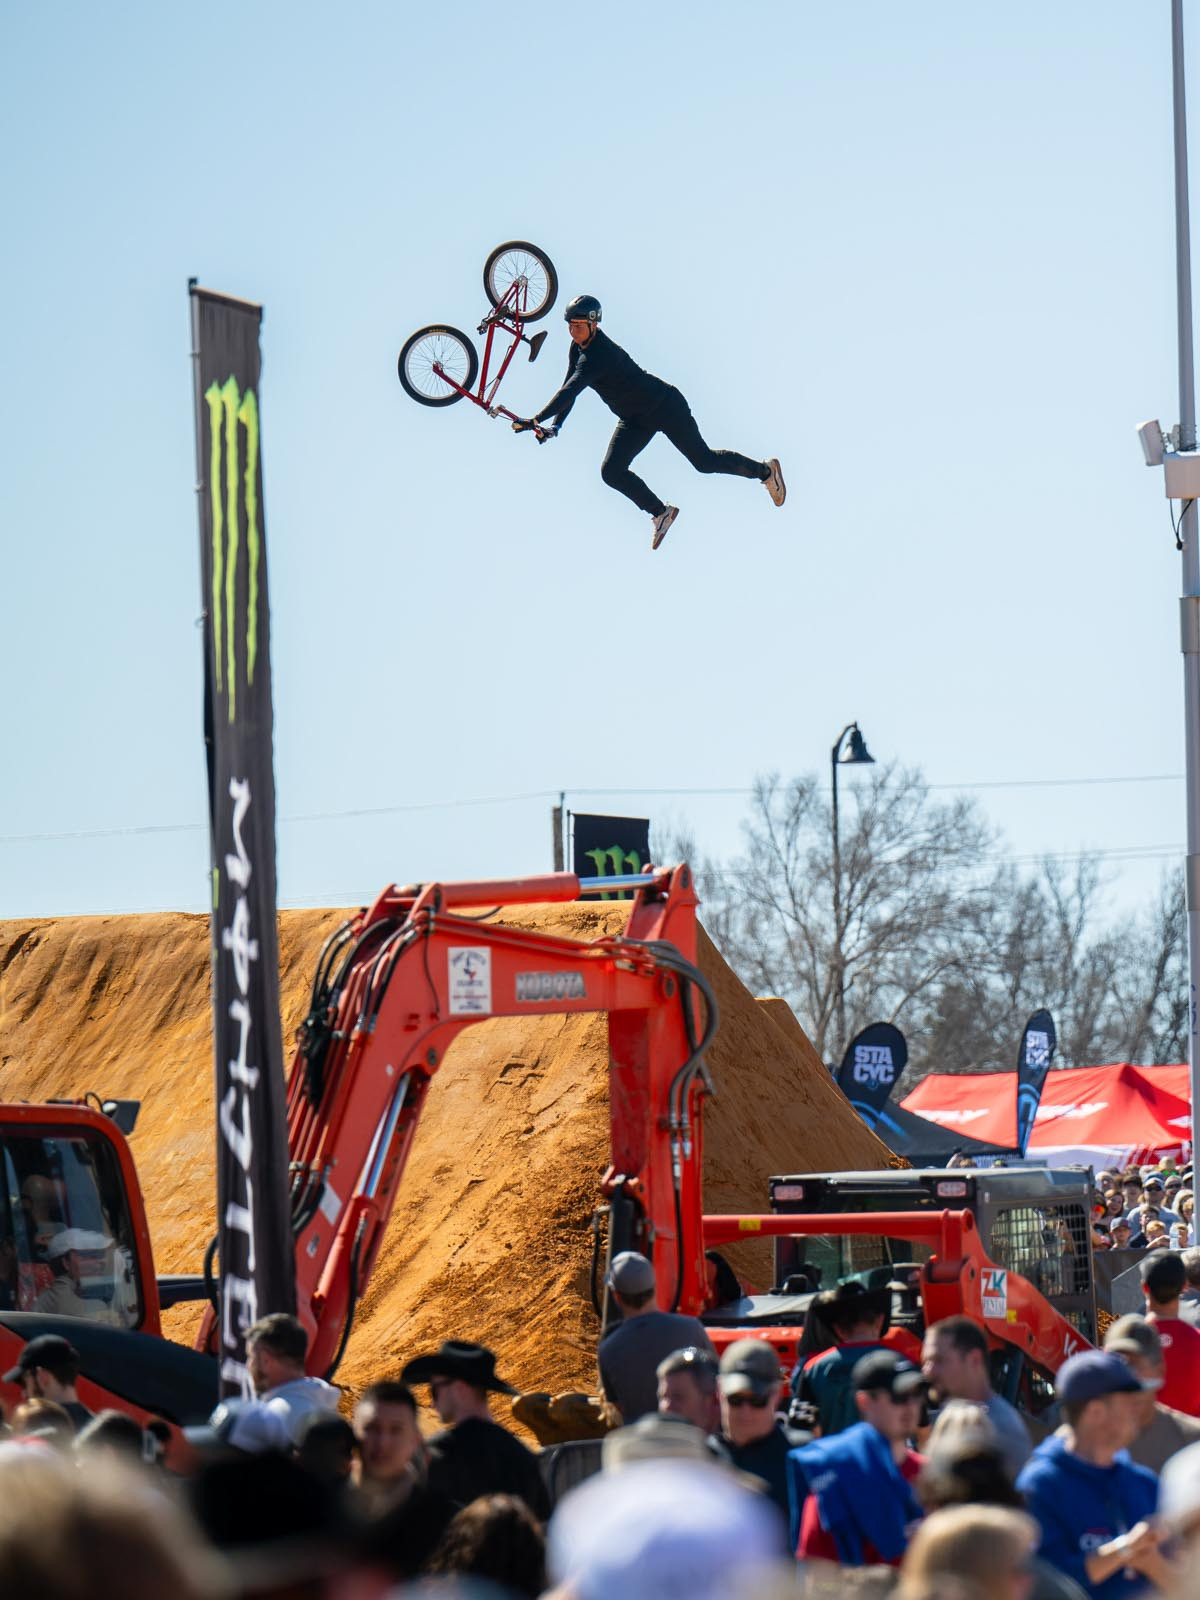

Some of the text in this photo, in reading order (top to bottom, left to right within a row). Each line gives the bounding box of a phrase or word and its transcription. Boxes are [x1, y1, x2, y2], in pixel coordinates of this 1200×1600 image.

[854, 1045, 893, 1064] STA
[853, 1064, 896, 1084] CYC
[982, 1270, 1006, 1297] ZK
